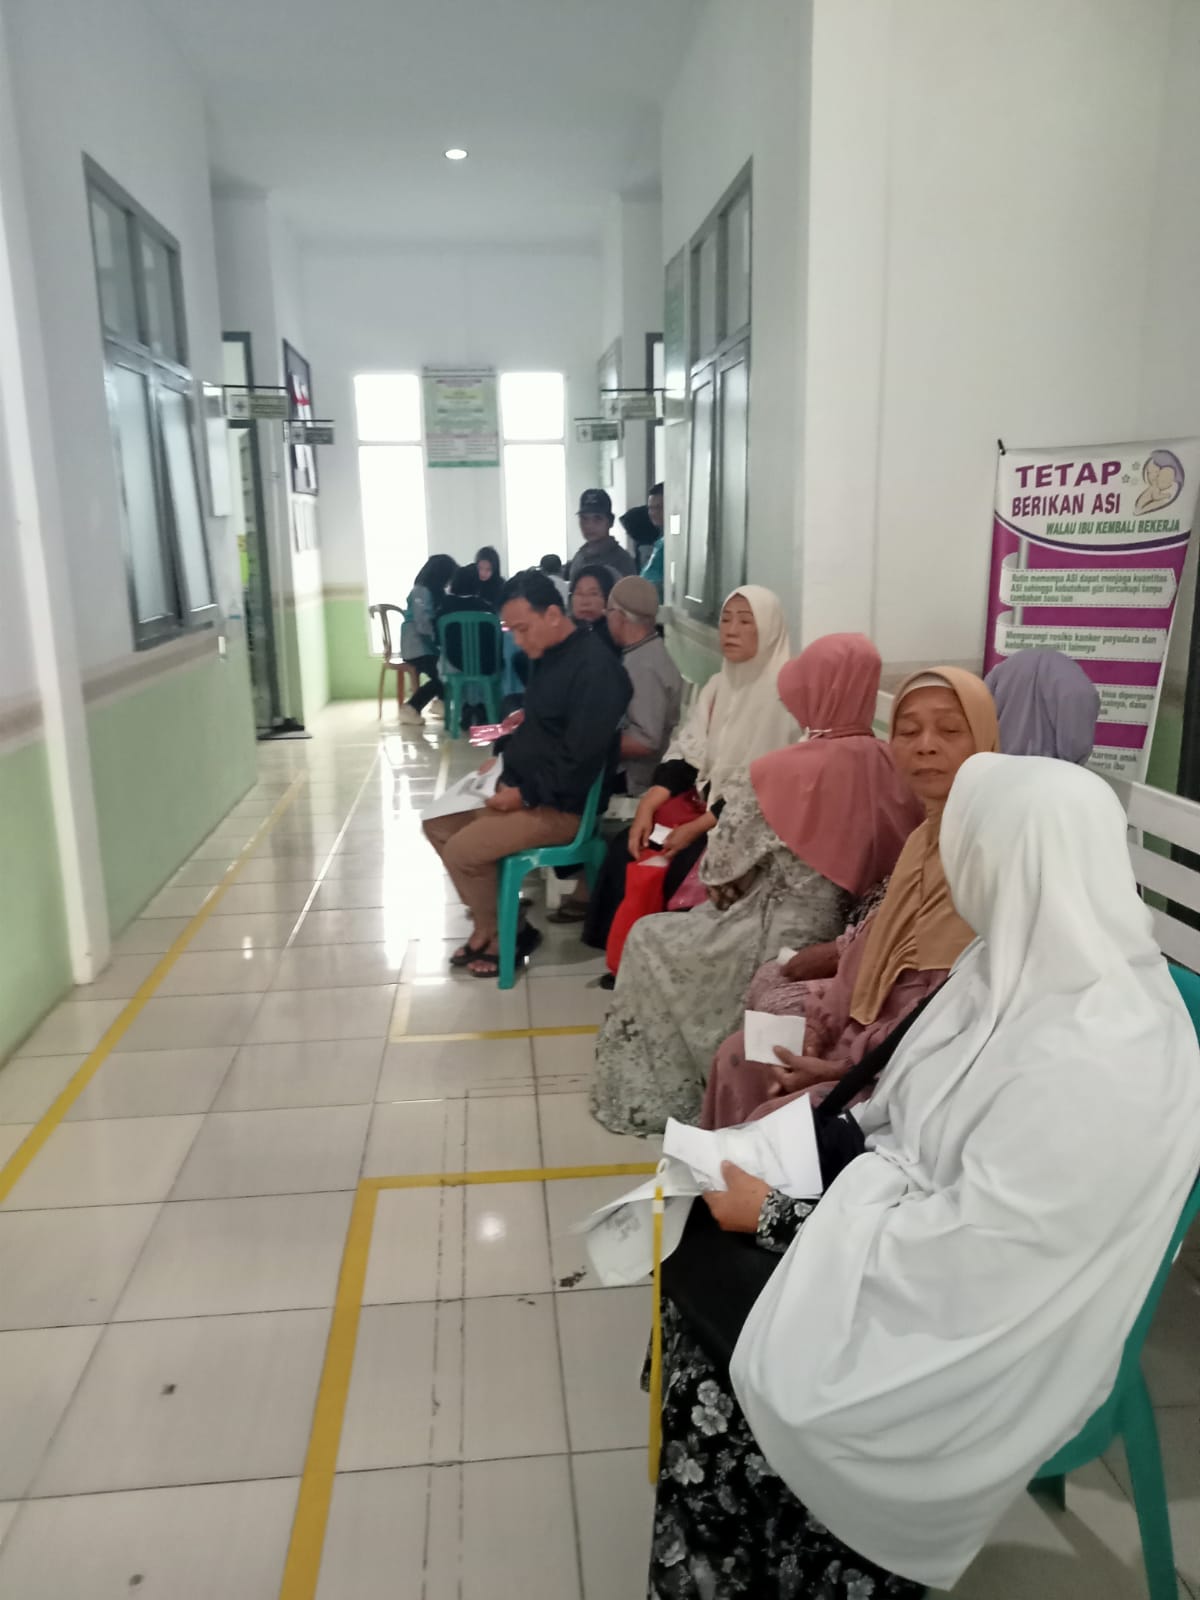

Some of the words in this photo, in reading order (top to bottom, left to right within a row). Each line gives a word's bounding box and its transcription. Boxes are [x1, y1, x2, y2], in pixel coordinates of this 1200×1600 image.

[1015, 461, 1121, 488] TETAP
[1012, 493, 1084, 517] BERIKAN
[1091, 492, 1121, 515] ASI
[1046, 521, 1077, 535] WALAU
[1078, 521, 1093, 534] IBU
[1095, 520, 1136, 534] KEMBALI
[1138, 519, 1180, 533] BEKERJA
[1066, 573, 1078, 582] ASI
[1079, 573, 1099, 584] dapat
[1101, 574, 1132, 585] menjaga
[1010, 584, 1023, 592] ASI
[1074, 632, 1100, 642] kanker
[1102, 633, 1139, 645] payudara
[1142, 634, 1157, 644] dan
